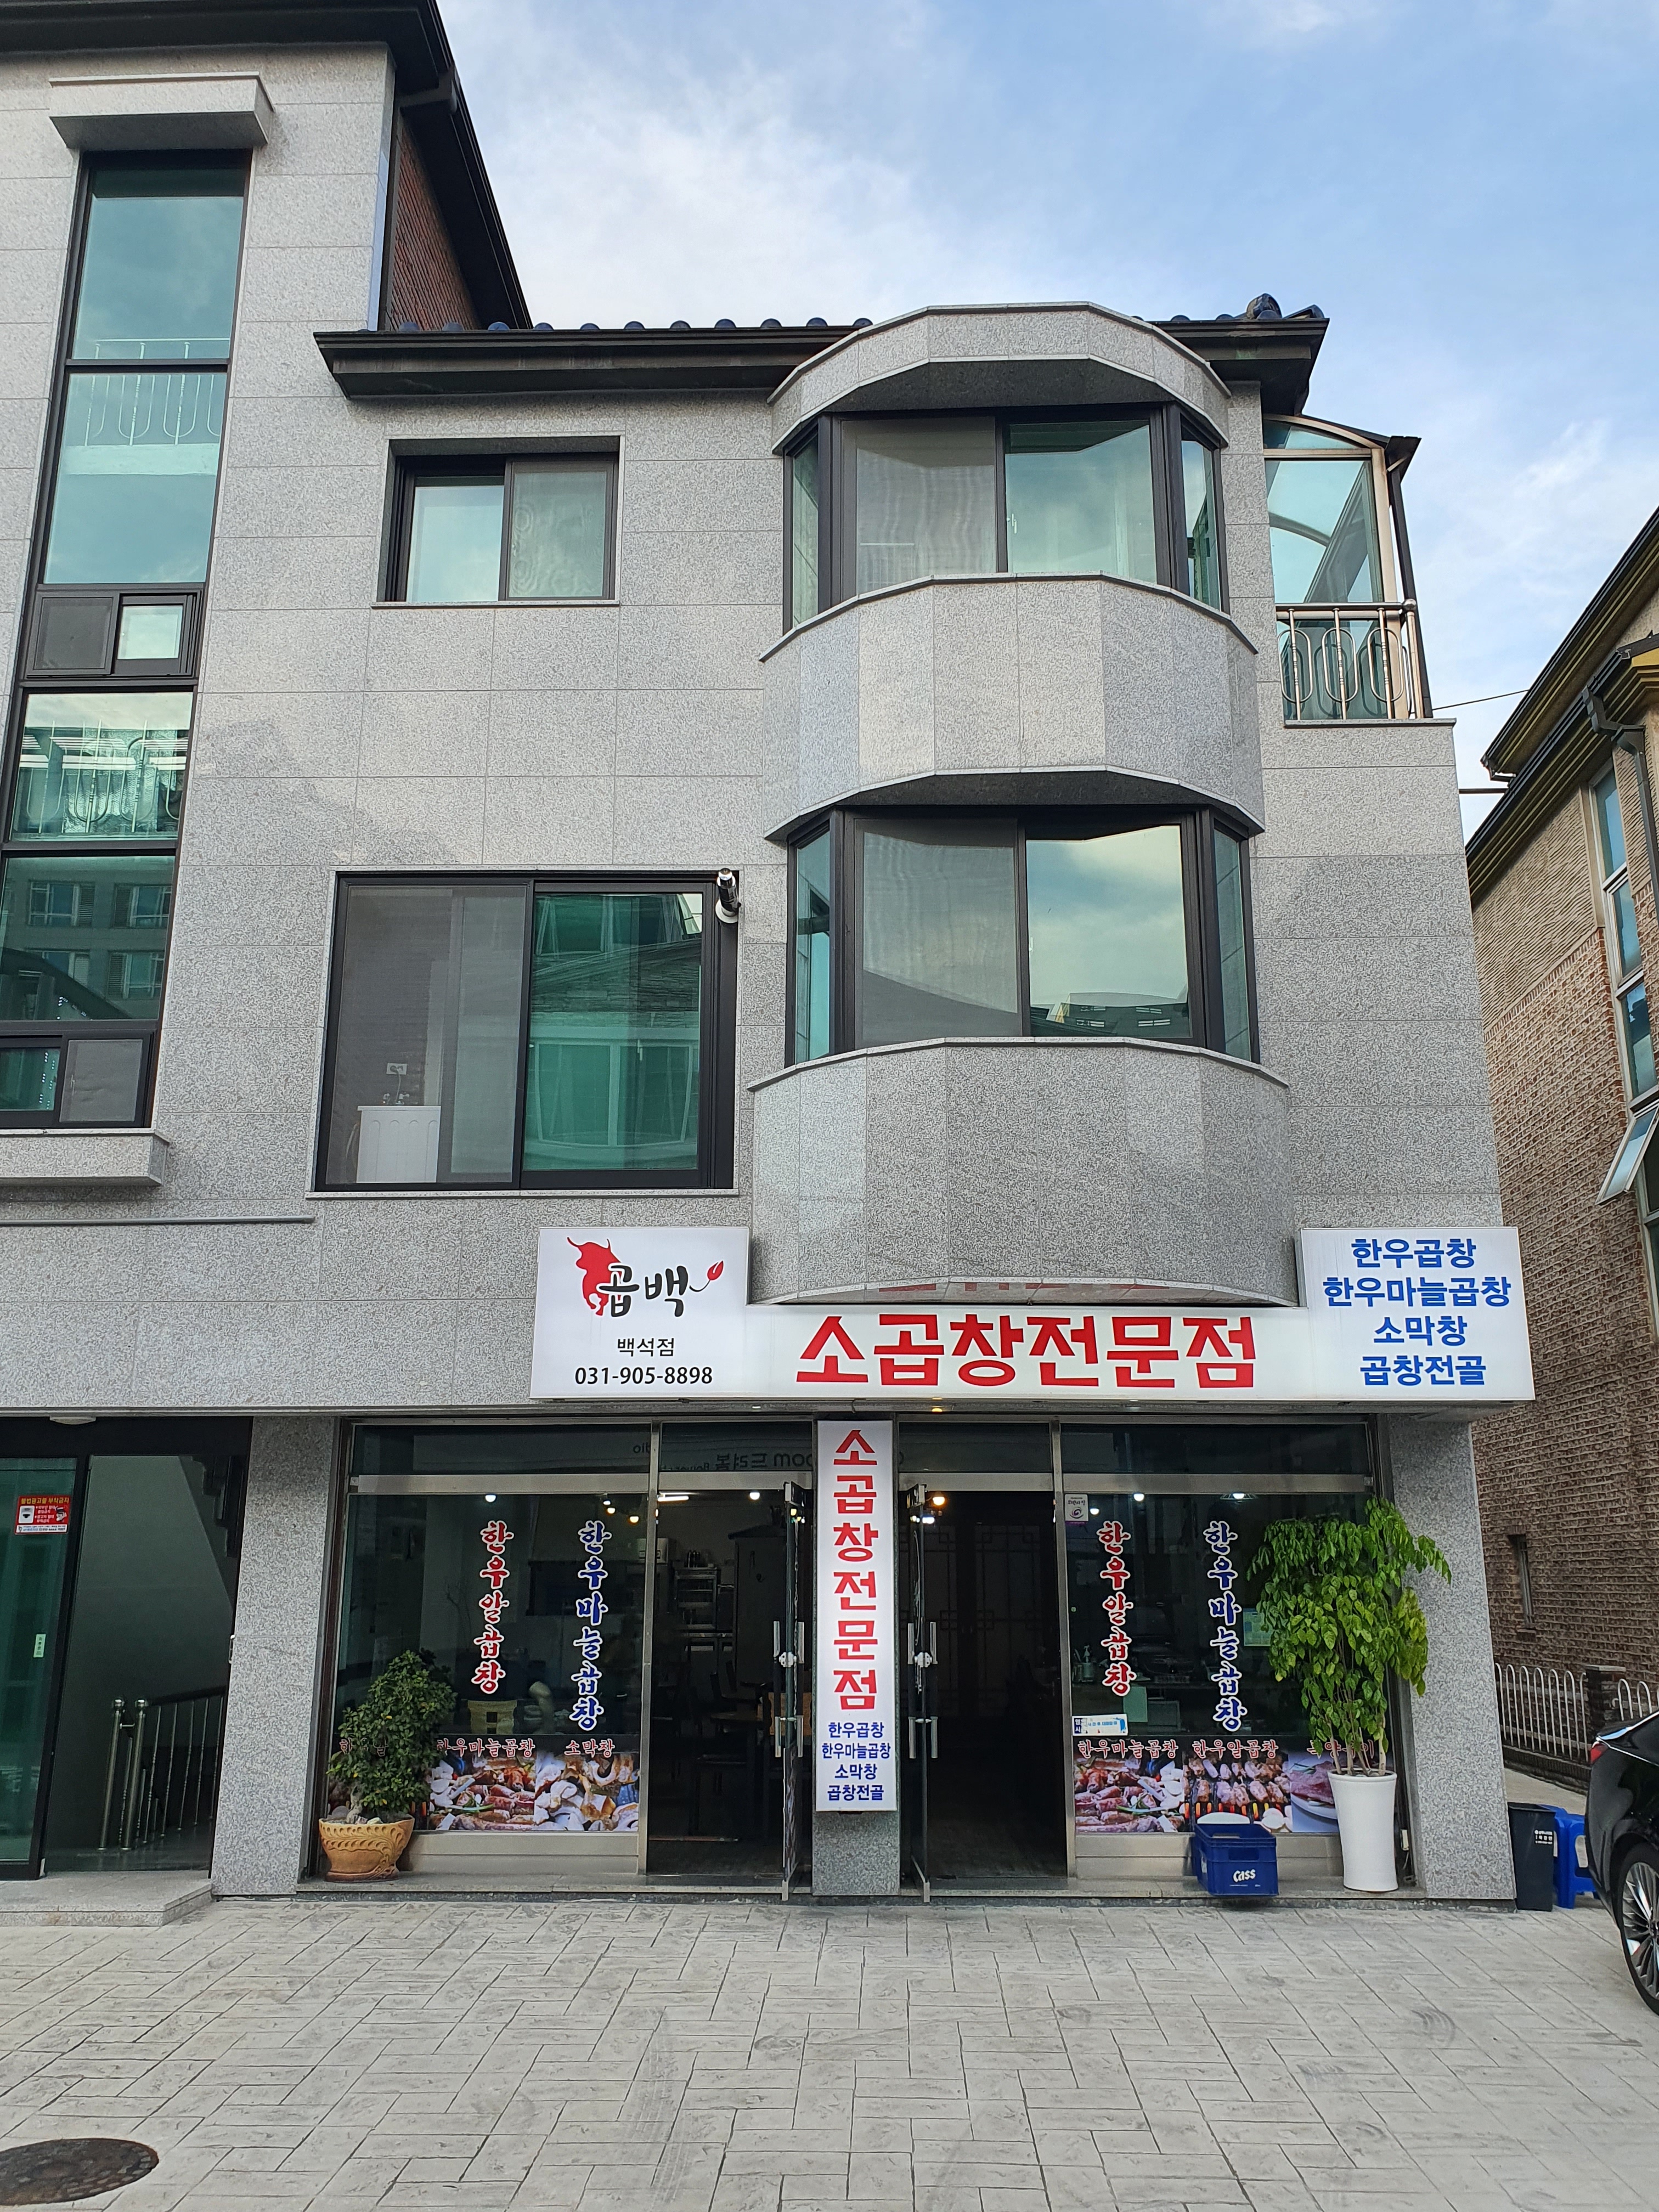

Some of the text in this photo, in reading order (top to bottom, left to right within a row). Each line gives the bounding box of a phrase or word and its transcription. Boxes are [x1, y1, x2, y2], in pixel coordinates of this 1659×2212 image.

[1351, 1238, 1476, 1268] 한우곱창
[598, 1264, 689, 1317] 곱백
[1323, 1277, 1511, 1307] 한우마늘곱창
[1373, 1316, 1468, 1346] 소막창
[617, 1338, 675, 1357] 백석점
[797, 1314, 1256, 1389] 소곱창전문점
[575, 1367, 713, 1385] 031-905-8898
[1360, 1355, 1486, 1386] 곱창전골
[833, 1430, 878, 1710] 소곱창전문점
[471, 1520, 515, 1694] 한우알곱창
[1096, 1520, 1137, 1696] 한우알곱창
[569, 1520, 612, 1731] 한우마늘곱창
[1203, 1520, 1248, 1732] 한우마늘곱창
[828, 1722, 884, 1739] 한우곱창
[437, 1737, 535, 1758] 한우마늘곱창
[564, 1737, 616, 1758] 소막창
[822, 1742, 891, 1759] 한우마늘곱창
[1077, 1739, 1179, 1759] 한우마늘곱창
[1192, 1739, 1279, 1759] 한우알곱창
[834, 1764, 878, 1780] 소막창
[827, 1785, 884, 1801] 곱창전골
[1233, 1869, 1256, 1882] Cass
